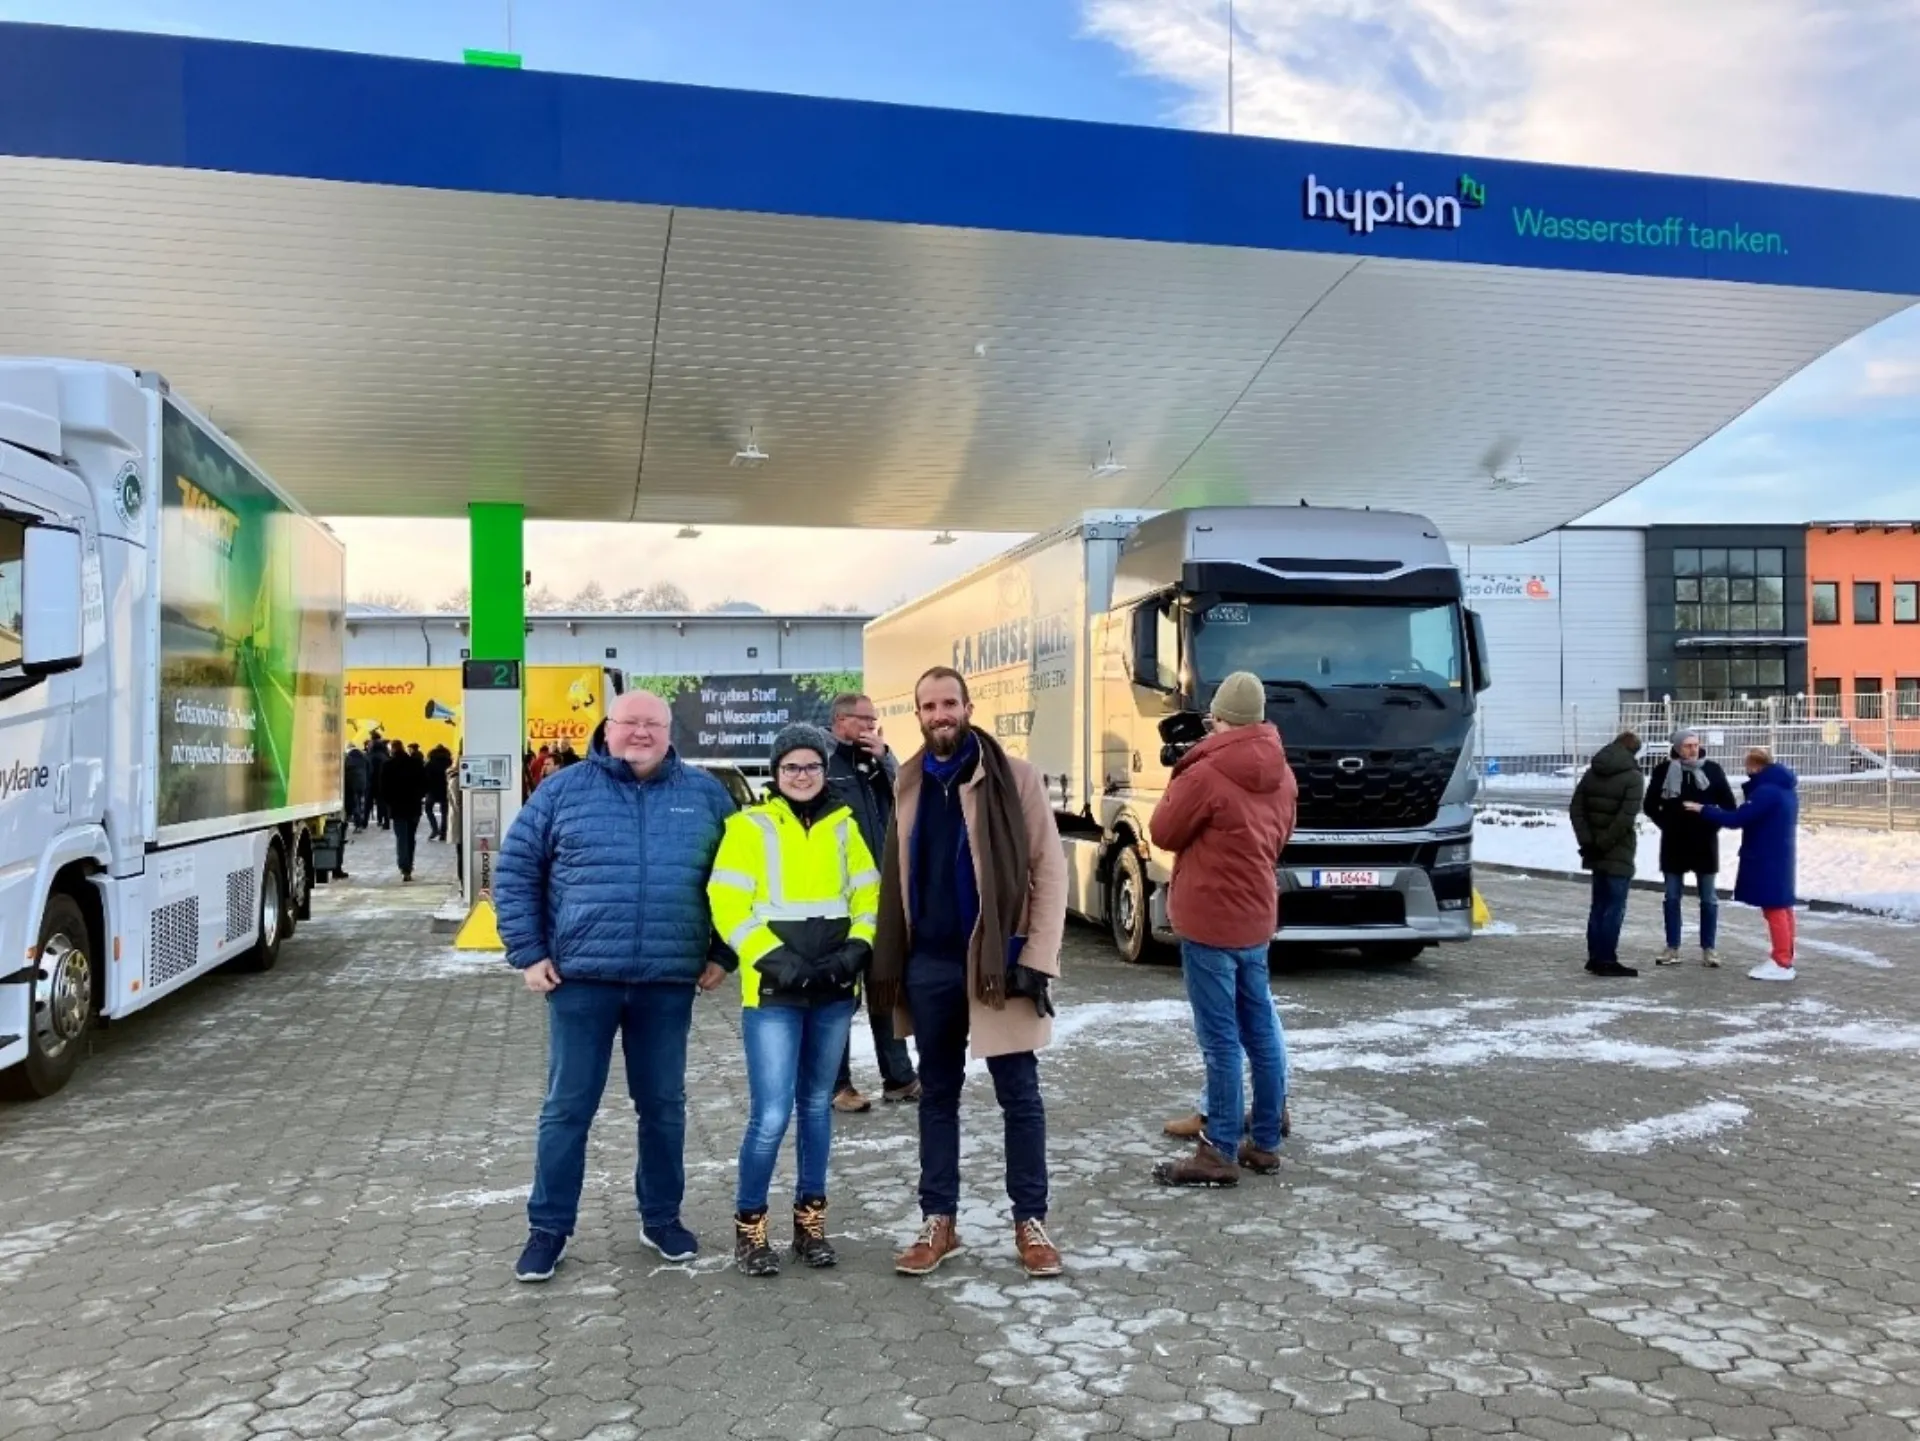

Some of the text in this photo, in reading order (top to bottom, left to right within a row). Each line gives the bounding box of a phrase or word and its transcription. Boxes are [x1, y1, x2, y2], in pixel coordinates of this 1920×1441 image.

[1307, 173, 1461, 233] hypion
[1511, 205, 1789, 255] Wasserstoff tanken.
[493, 663, 509, 686] 2
[527, 718, 589, 739] Netto
[0, 759, 49, 800] ylane
